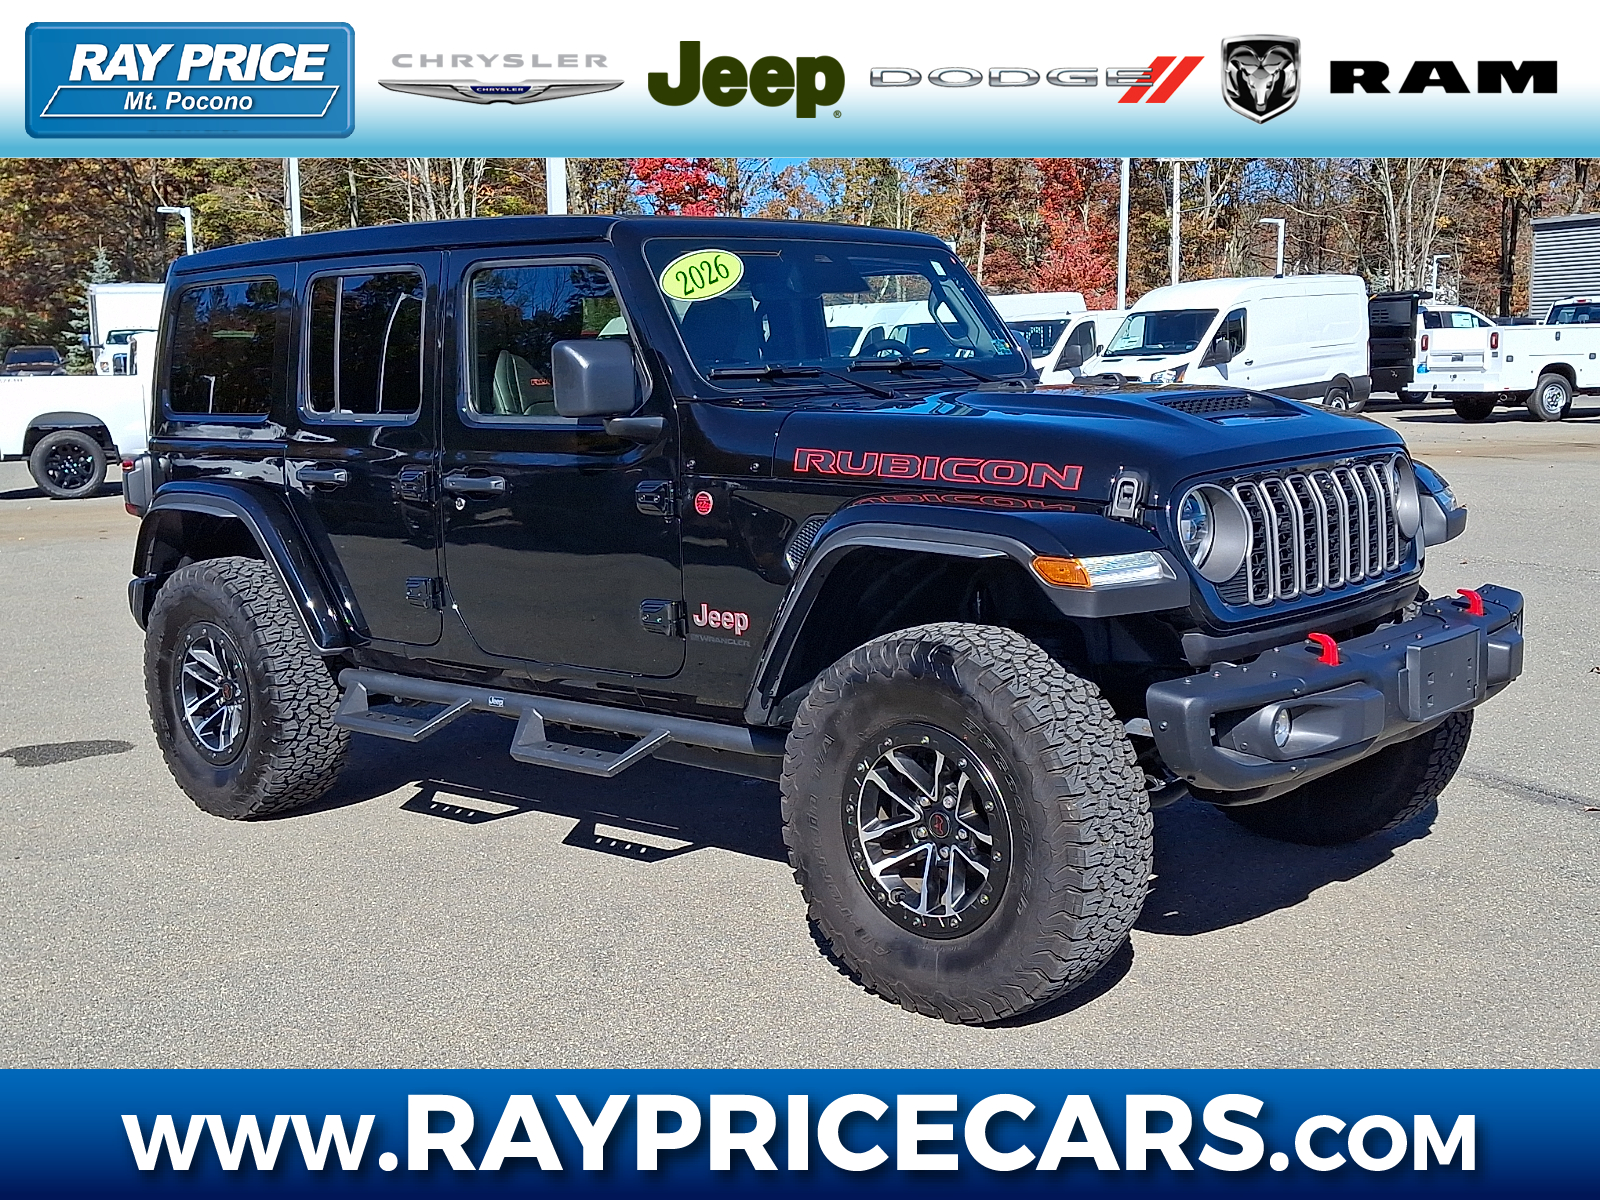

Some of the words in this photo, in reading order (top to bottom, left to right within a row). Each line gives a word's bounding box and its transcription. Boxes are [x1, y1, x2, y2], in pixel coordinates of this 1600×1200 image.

[675, 254, 730, 296] 2026
[793, 447, 1083, 491] RUBICON
[692, 603, 750, 636] Jeep
[699, 634, 751, 648] WRANGLER
